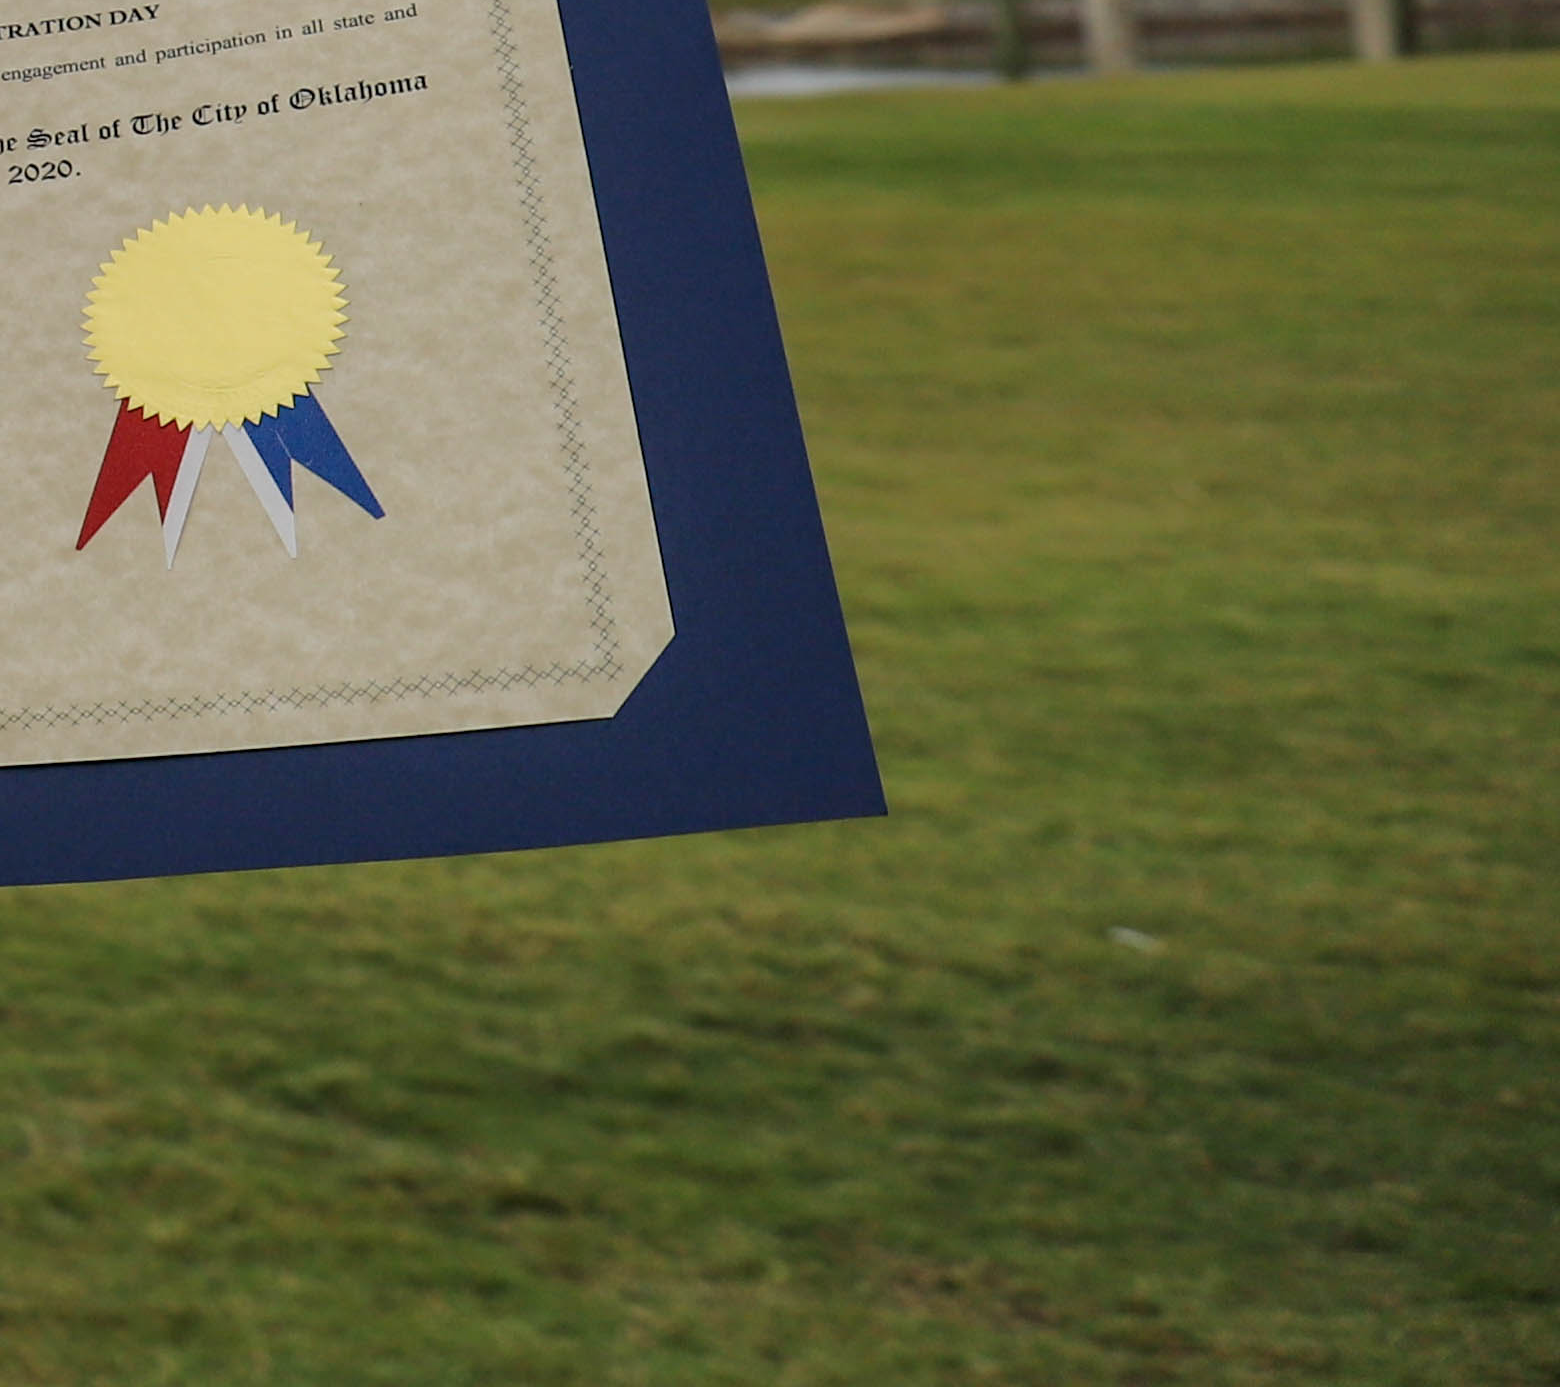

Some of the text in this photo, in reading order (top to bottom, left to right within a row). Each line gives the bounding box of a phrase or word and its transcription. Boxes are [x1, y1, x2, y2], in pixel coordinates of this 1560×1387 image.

[108, 3, 160, 26] DAY
[0, 56, 106, 83] engagement
[114, 48, 147, 67] and
[154, 32, 267, 65] participation
[275, 27, 293, 40] in
[301, 18, 324, 36] all
[333, 13, 375, 31] state
[383, 2, 418, 22] and
[26, 122, 91, 150] Seal
[98, 118, 121, 141] of
[129, 111, 183, 137] The
[191, 103, 248, 127] City
[257, 93, 281, 116] of
[288, 75, 429, 111] Oklahoma
[7, 159, 82, 185] 2020.
